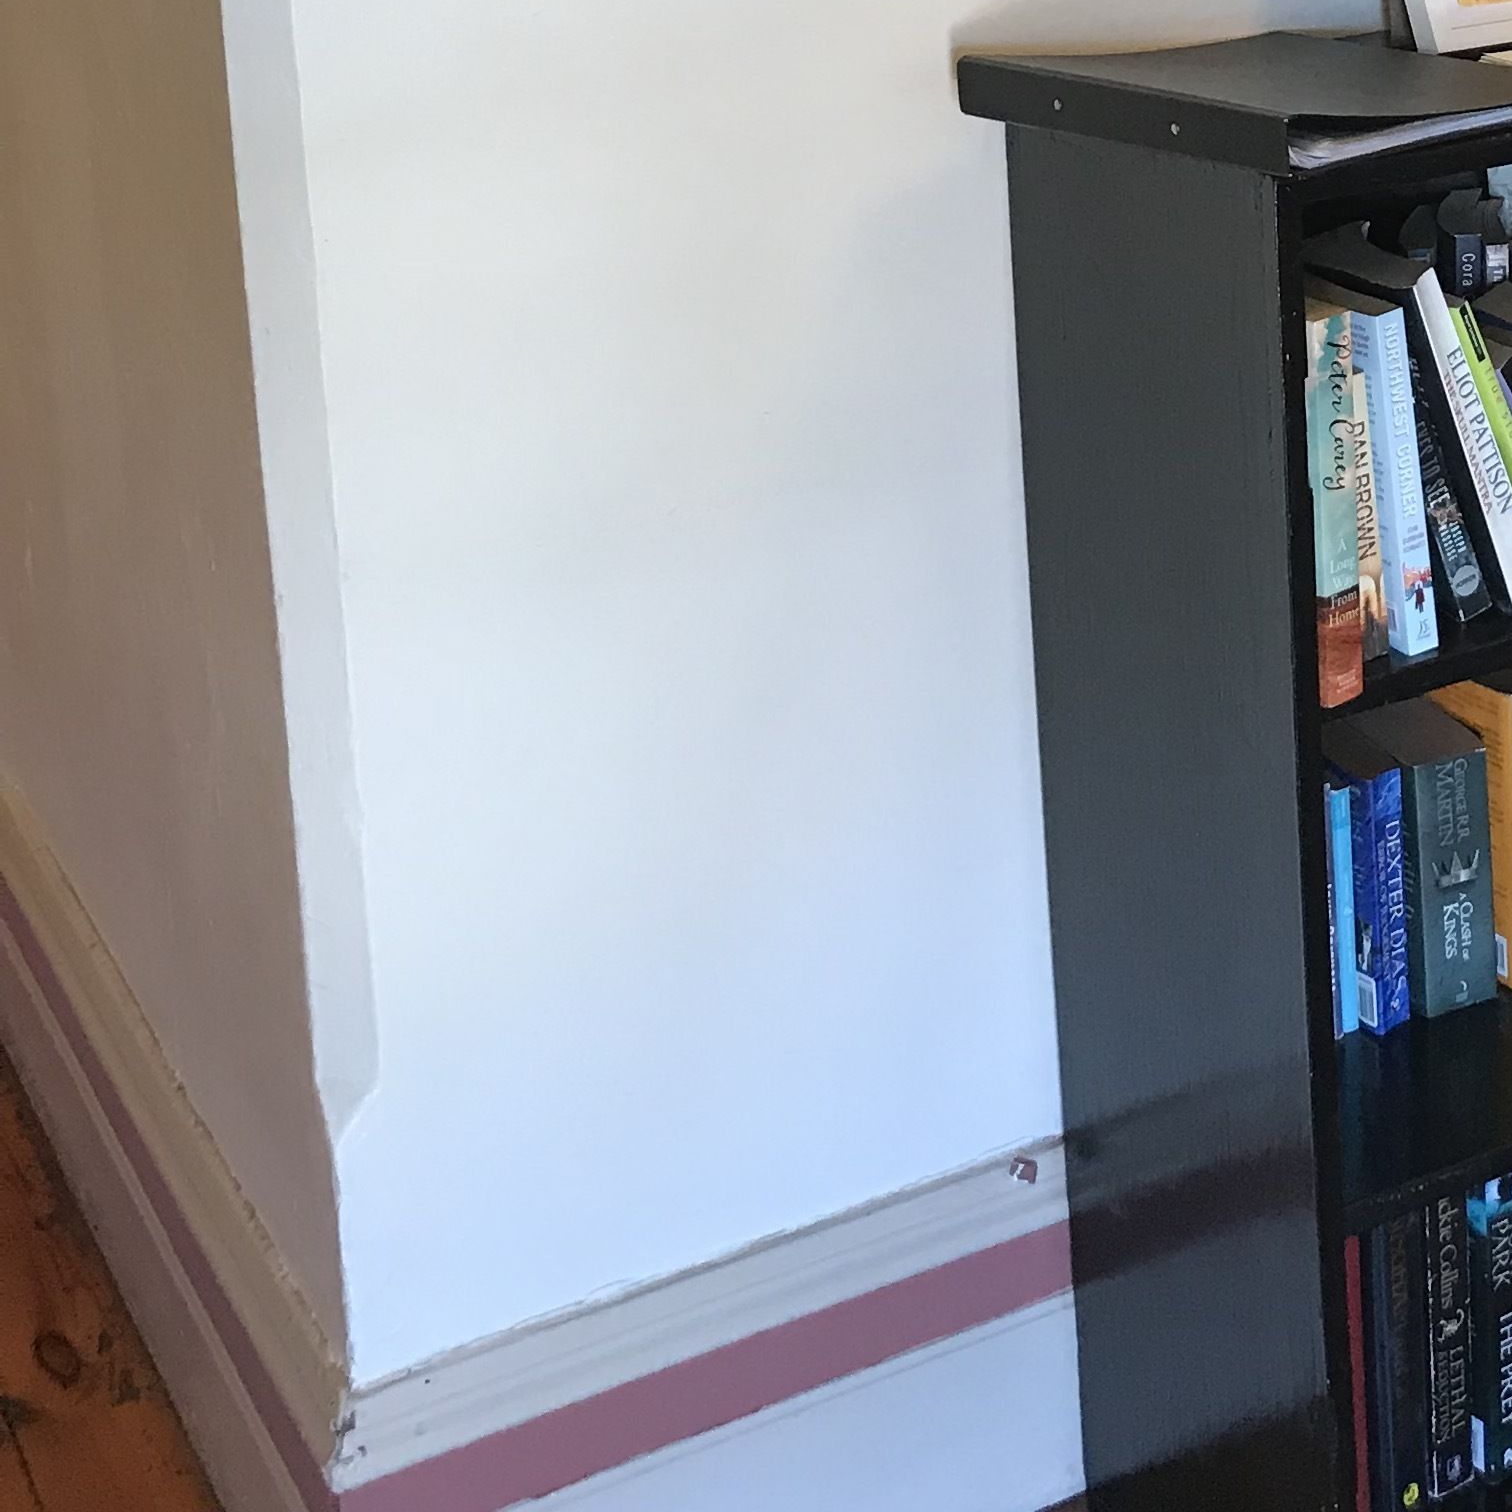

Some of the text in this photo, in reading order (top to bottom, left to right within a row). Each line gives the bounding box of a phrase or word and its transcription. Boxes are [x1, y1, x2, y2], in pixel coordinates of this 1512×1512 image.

[1461, 252, 1476, 288] Cora
[1323, 335, 1354, 491] Peter Carey
[1384, 322, 1410, 440] NORTHWEST
[1446, 345, 1481, 410] ELIOT
[1353, 421, 1370, 467] DAN
[1466, 443, 1493, 515] MANTRA
[1395, 444, 1418, 519] CORNER
[1425, 478, 1451, 509] SEE
[1356, 476, 1378, 562] BROWN
[1328, 607, 1359, 629] Home
[1331, 591, 1358, 610] From
[1434, 762, 1456, 846] MARTIN
[1453, 757, 1469, 813] GEORGE
[1384, 819, 1408, 993] DEXTER DIAS
[1442, 903, 1461, 960] KINGS
[1459, 901, 1474, 946] CLASH
[1437, 1197, 1460, 1309] ckie Collins
[1490, 1219, 1510, 1292] PARK
[1448, 1345, 1468, 1437] LETHAL
